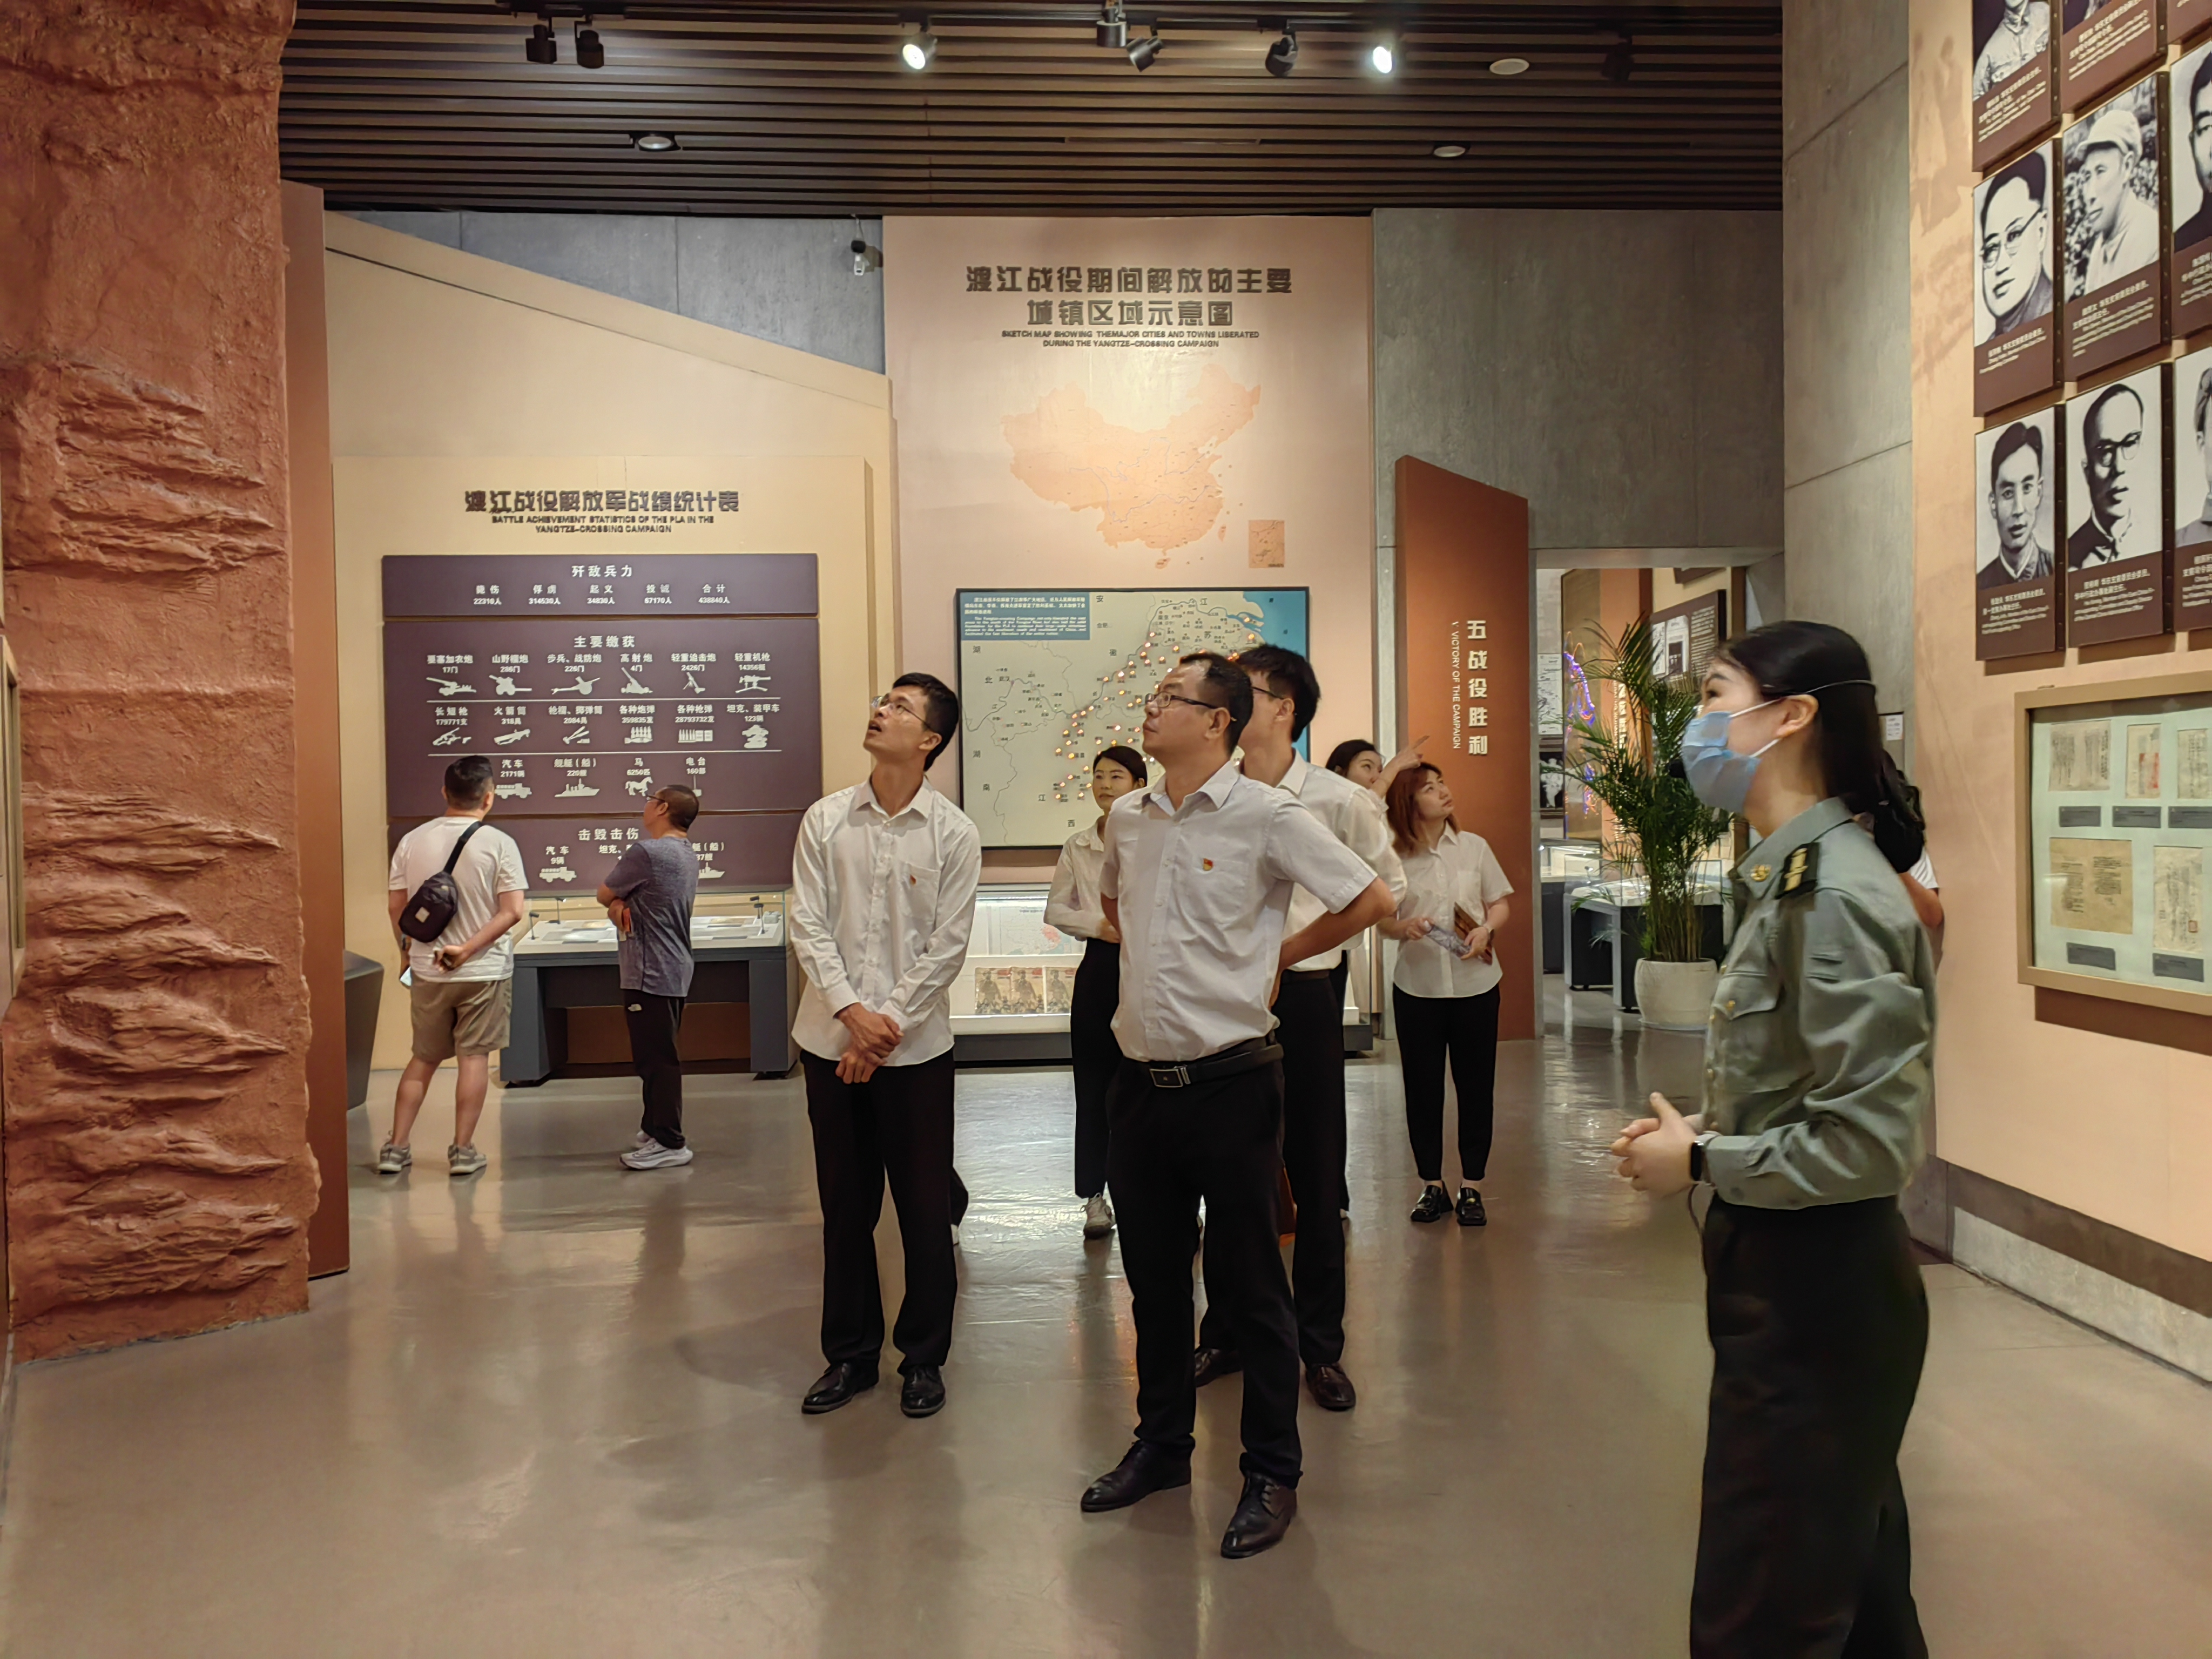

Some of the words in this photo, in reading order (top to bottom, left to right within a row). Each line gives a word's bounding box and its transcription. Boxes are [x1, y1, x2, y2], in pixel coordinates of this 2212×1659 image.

[966, 265, 1292, 294] 渡江战役期间解放的主要
[1027, 299, 1233, 326] 城镇区域示意图
[1177, 340, 1219, 348] CAMPAIGN
[464, 490, 739, 514] 渡江战役解放军战绩统计表
[492, 515, 524, 523] BATTLE
[526, 515, 586, 523] ACHIEVEMENT
[589, 515, 636, 523] STATISTICS
[638, 515, 649, 523] OF
[687, 516, 696, 524] IN
[535, 525, 624, 533] YANGTZE-CROSSING
[625, 525, 672, 533] CAMPAIGN
[571, 564, 632, 578] 歼敌兵力
[590, 584, 613, 594] 起义
[702, 584, 726, 593] 合计
[574, 635, 635, 648] 主要缴获
[1452, 631, 1460, 669] VICTORY
[620, 653, 653, 663] 高射炮
[671, 653, 717, 662] 轻重迫击炮
[734, 652, 771, 662] 轻重机枪
[1452, 671, 1460, 683] OF
[1467, 620, 1488, 754] 五战役胜利
[1452, 685, 1460, 702] THE
[435, 706, 468, 716] 长短枪
[494, 706, 527, 716] 火箭筒
[619, 705, 655, 714] 各种炮弹
[677, 704, 713, 714] 各种枪弹
[726, 704, 780, 713] 坦克、装甲车
[1452, 704, 1461, 748] CAMPAIGN
[502, 759, 523, 768] 汽车
[634, 758, 643, 767] 马
[686, 757, 705, 766] 电台
[1068, 819, 1075, 827] 西
[578, 827, 639, 841] 击毁击伤
[545, 846, 569, 855] 汽车
